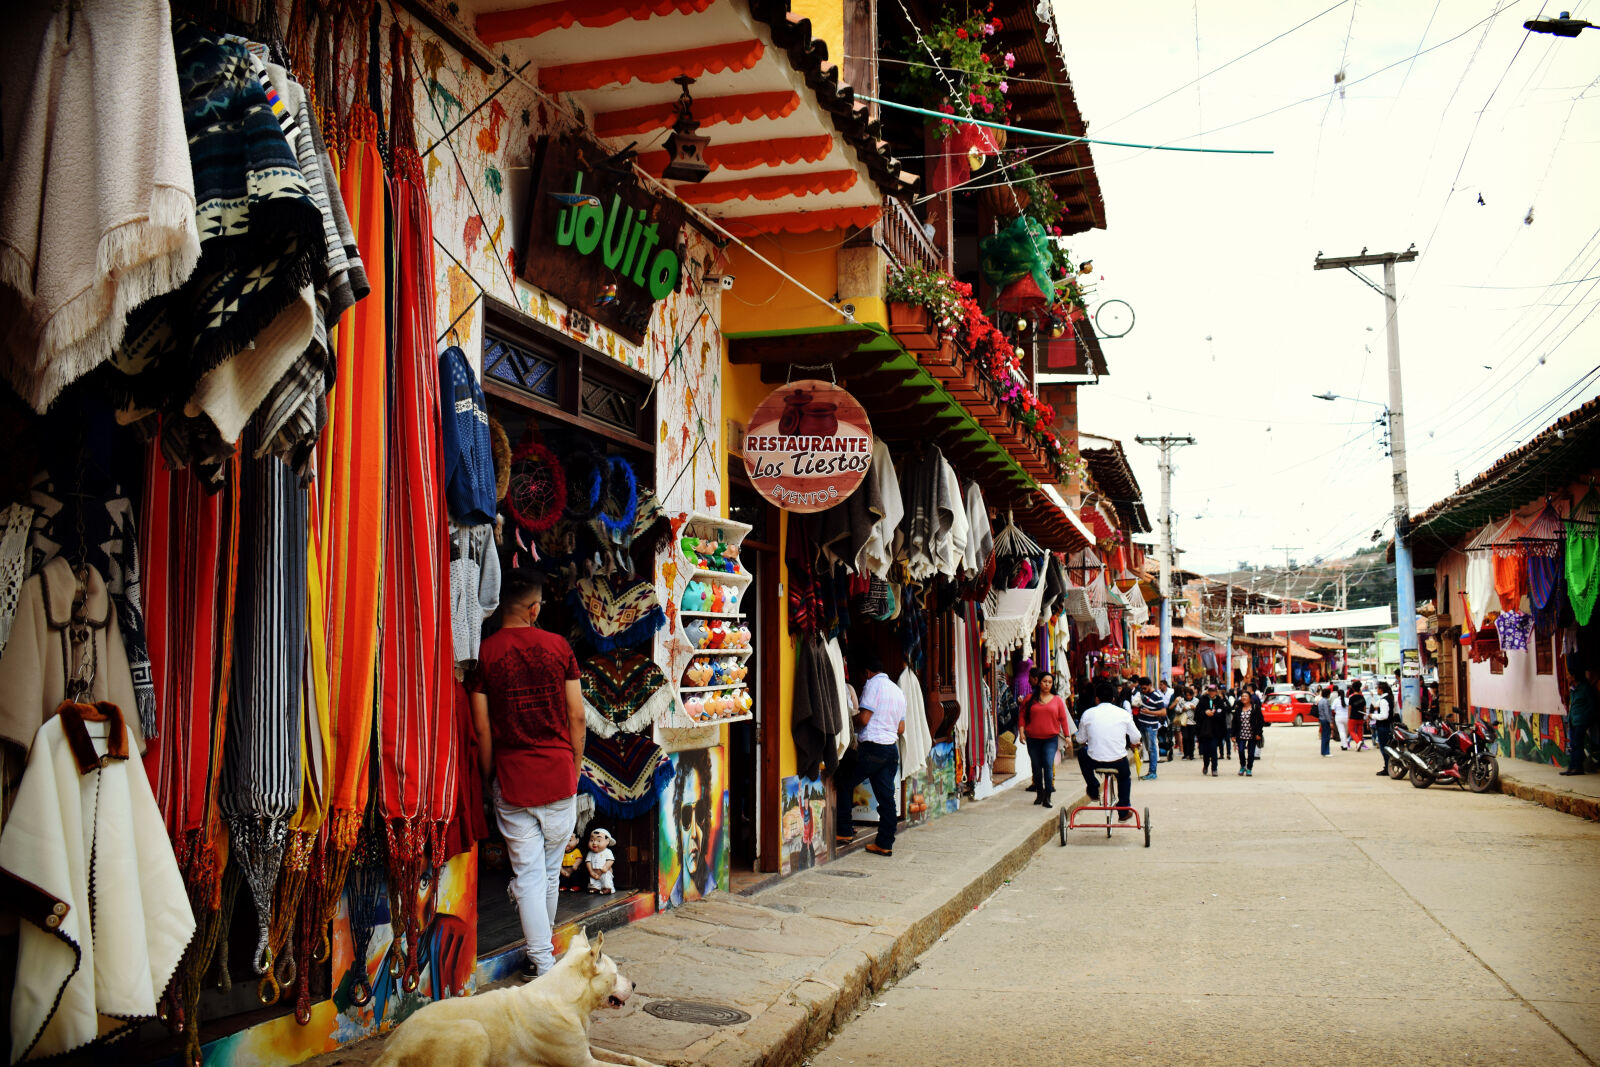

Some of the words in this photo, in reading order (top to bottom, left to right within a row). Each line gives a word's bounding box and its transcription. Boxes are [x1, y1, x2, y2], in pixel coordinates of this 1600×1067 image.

[747, 436, 868, 452] RESTAURANTE
[752, 456, 784, 479] Los
[791, 451, 871, 476] Tiestos
[772, 485, 838, 505] EVENTOS
